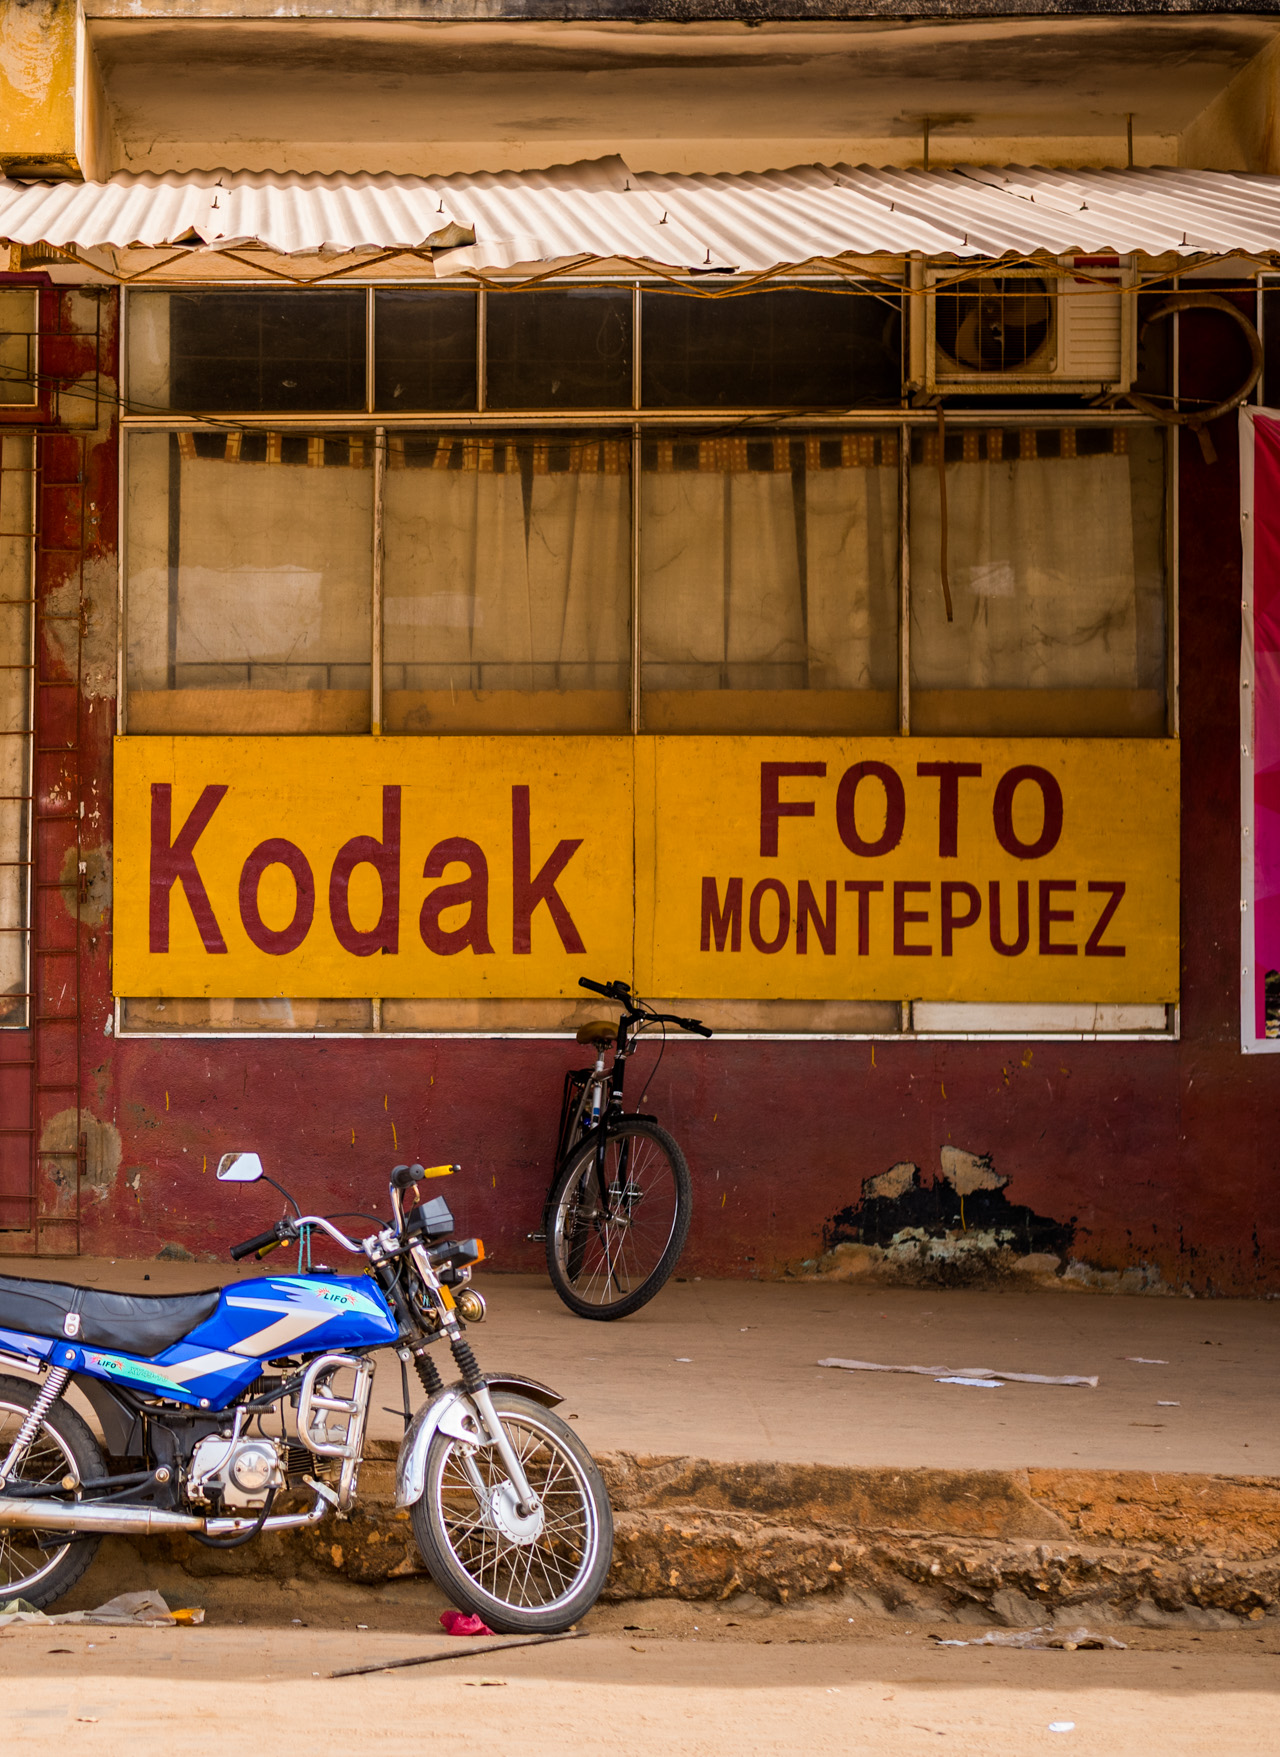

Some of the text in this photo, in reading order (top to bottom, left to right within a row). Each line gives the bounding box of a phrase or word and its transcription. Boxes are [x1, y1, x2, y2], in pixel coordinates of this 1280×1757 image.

[760, 761, 1065, 860] FOTO
[149, 782, 588, 957] Kodak
[700, 877, 1127, 958] MONTEPUEZ
[324, 1293, 348, 1304] LIFO
[97, 1360, 117, 1369] LIFO
